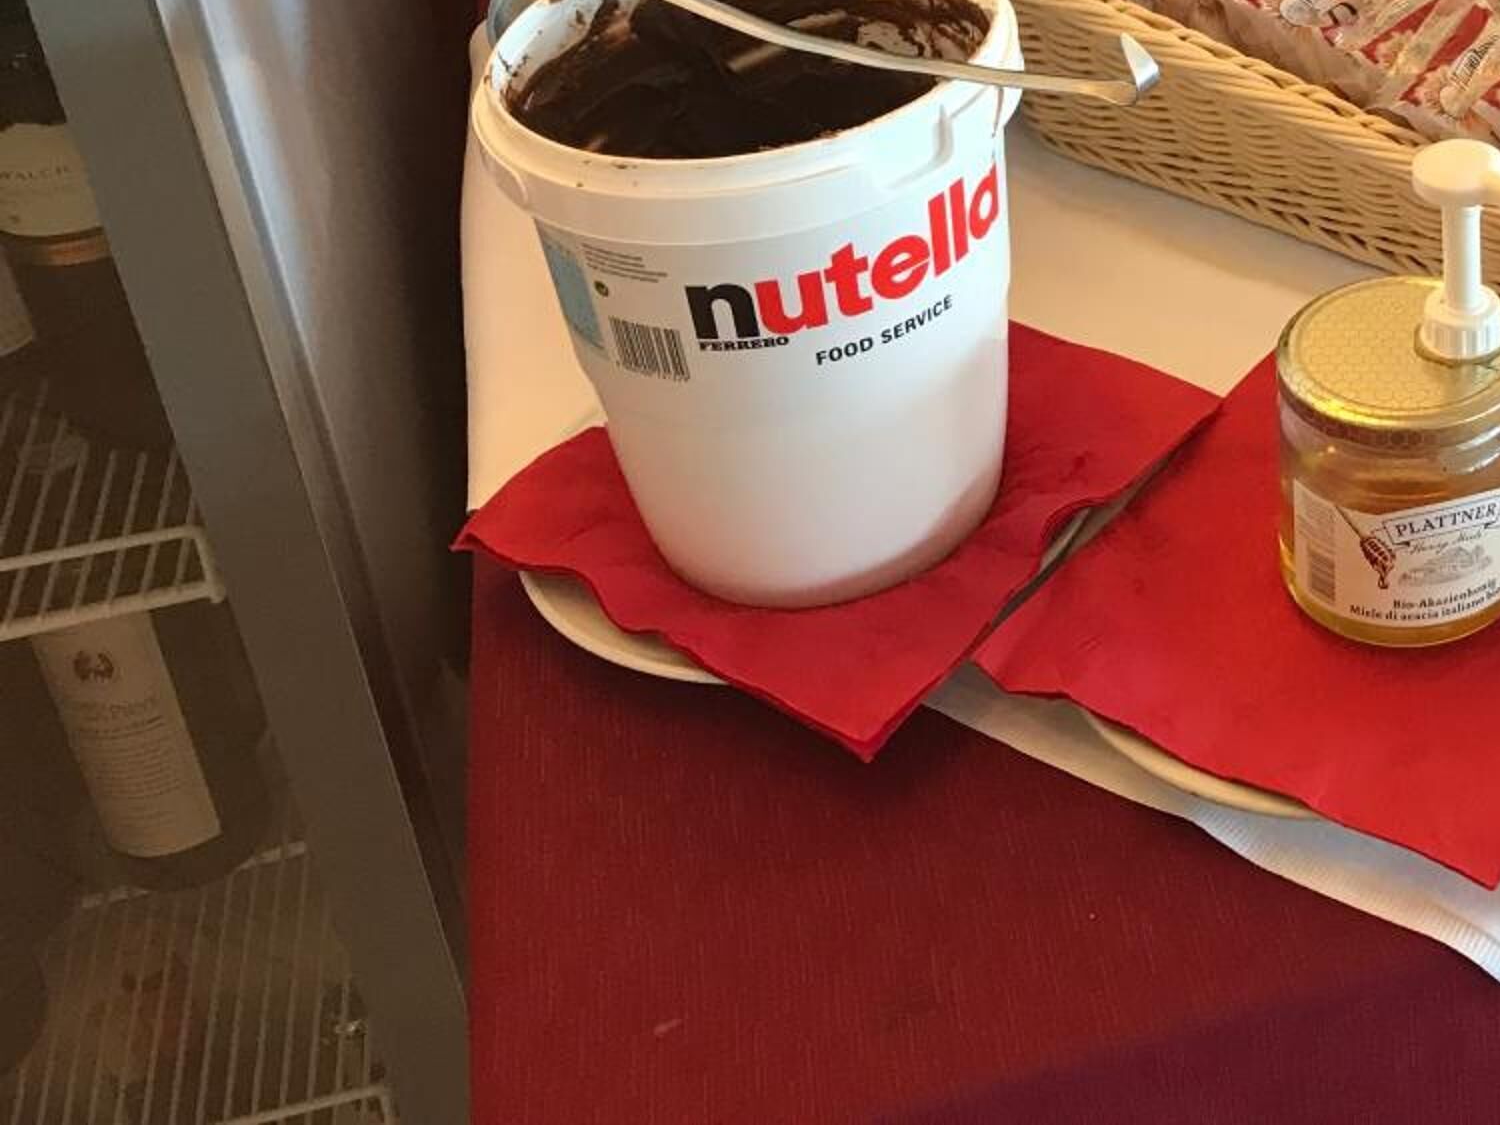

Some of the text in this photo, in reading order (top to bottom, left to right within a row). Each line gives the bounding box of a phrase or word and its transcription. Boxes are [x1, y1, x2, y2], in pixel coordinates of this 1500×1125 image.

[684, 163, 999, 339] nutella
[699, 336, 790, 353] FERRERO
[815, 293, 954, 367] FOOD SERVICE
[1395, 502, 1498, 539] PLATTNER
